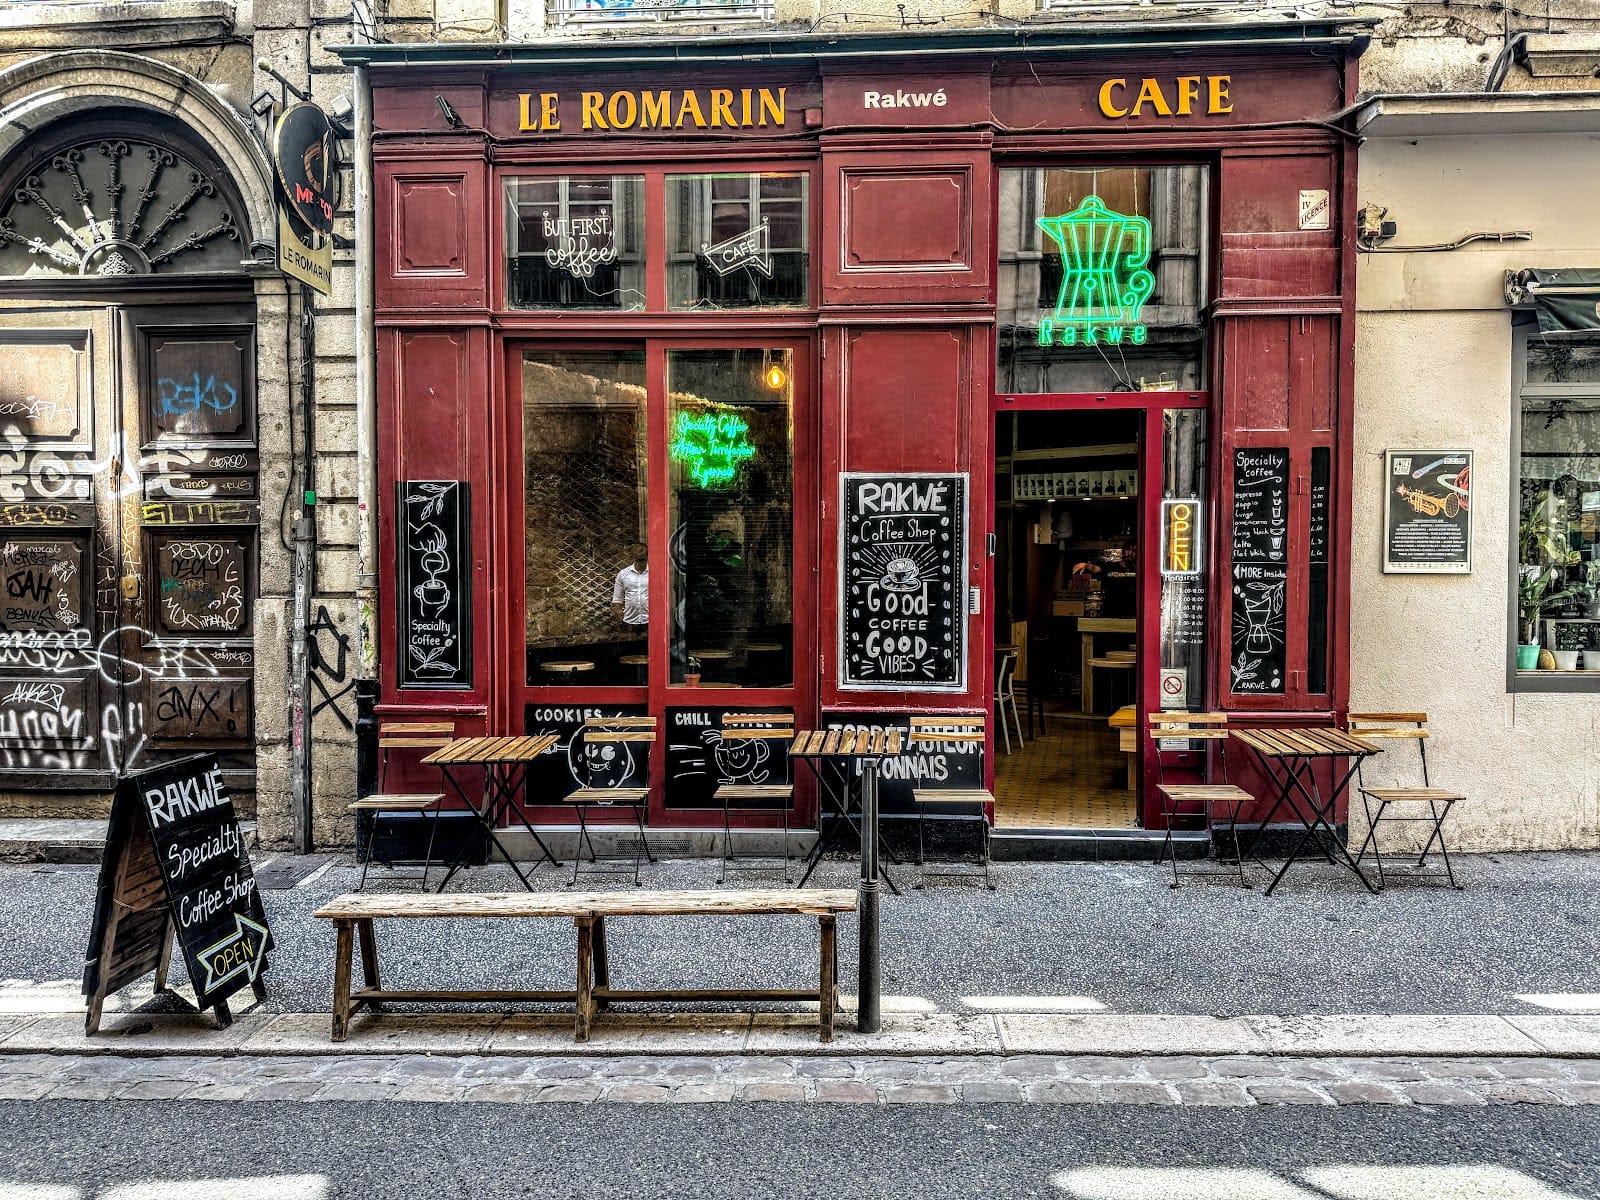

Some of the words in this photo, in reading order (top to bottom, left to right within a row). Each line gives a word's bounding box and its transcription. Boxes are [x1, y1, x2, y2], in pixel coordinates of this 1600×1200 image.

[518, 93, 560, 131] LE
[581, 87, 788, 130] ROMARIN
[863, 89, 948, 109] Rakwé
[1098, 75, 1234, 118] CAFE
[1301, 198, 1328, 225] LICENCE
[544, 218, 568, 237] BUT
[571, 216, 614, 239] FIRST,
[283, 244, 293, 263] LE
[295, 251, 331, 285] ROMARIN
[547, 236, 615, 275] coffee
[1236, 451, 1283, 471] Specialty
[1245, 467, 1274, 478] coffee
[858, 480, 948, 516] RAKWÉ
[859, 519, 904, 543] Coffee
[907, 518, 937, 544] Shop
[1172, 503, 1191, 571] OPEN
[1240, 566, 1262, 578] MORE
[1263, 568, 1287, 579] inside
[411, 619, 450, 637] Specialty
[868, 617, 929, 631] COFFEE
[411, 634, 441, 646] Coffee
[878, 653, 917, 674] VIBES
[675, 712, 711, 726] CHILL
[855, 754, 949, 781] LONNAIS
[146, 763, 230, 829] RAKWÉ
[168, 823, 241, 880] Specialty
[180, 888, 222, 928] Coffee
[224, 875, 255, 908] Shop
[213, 938, 254, 977] OPEN
